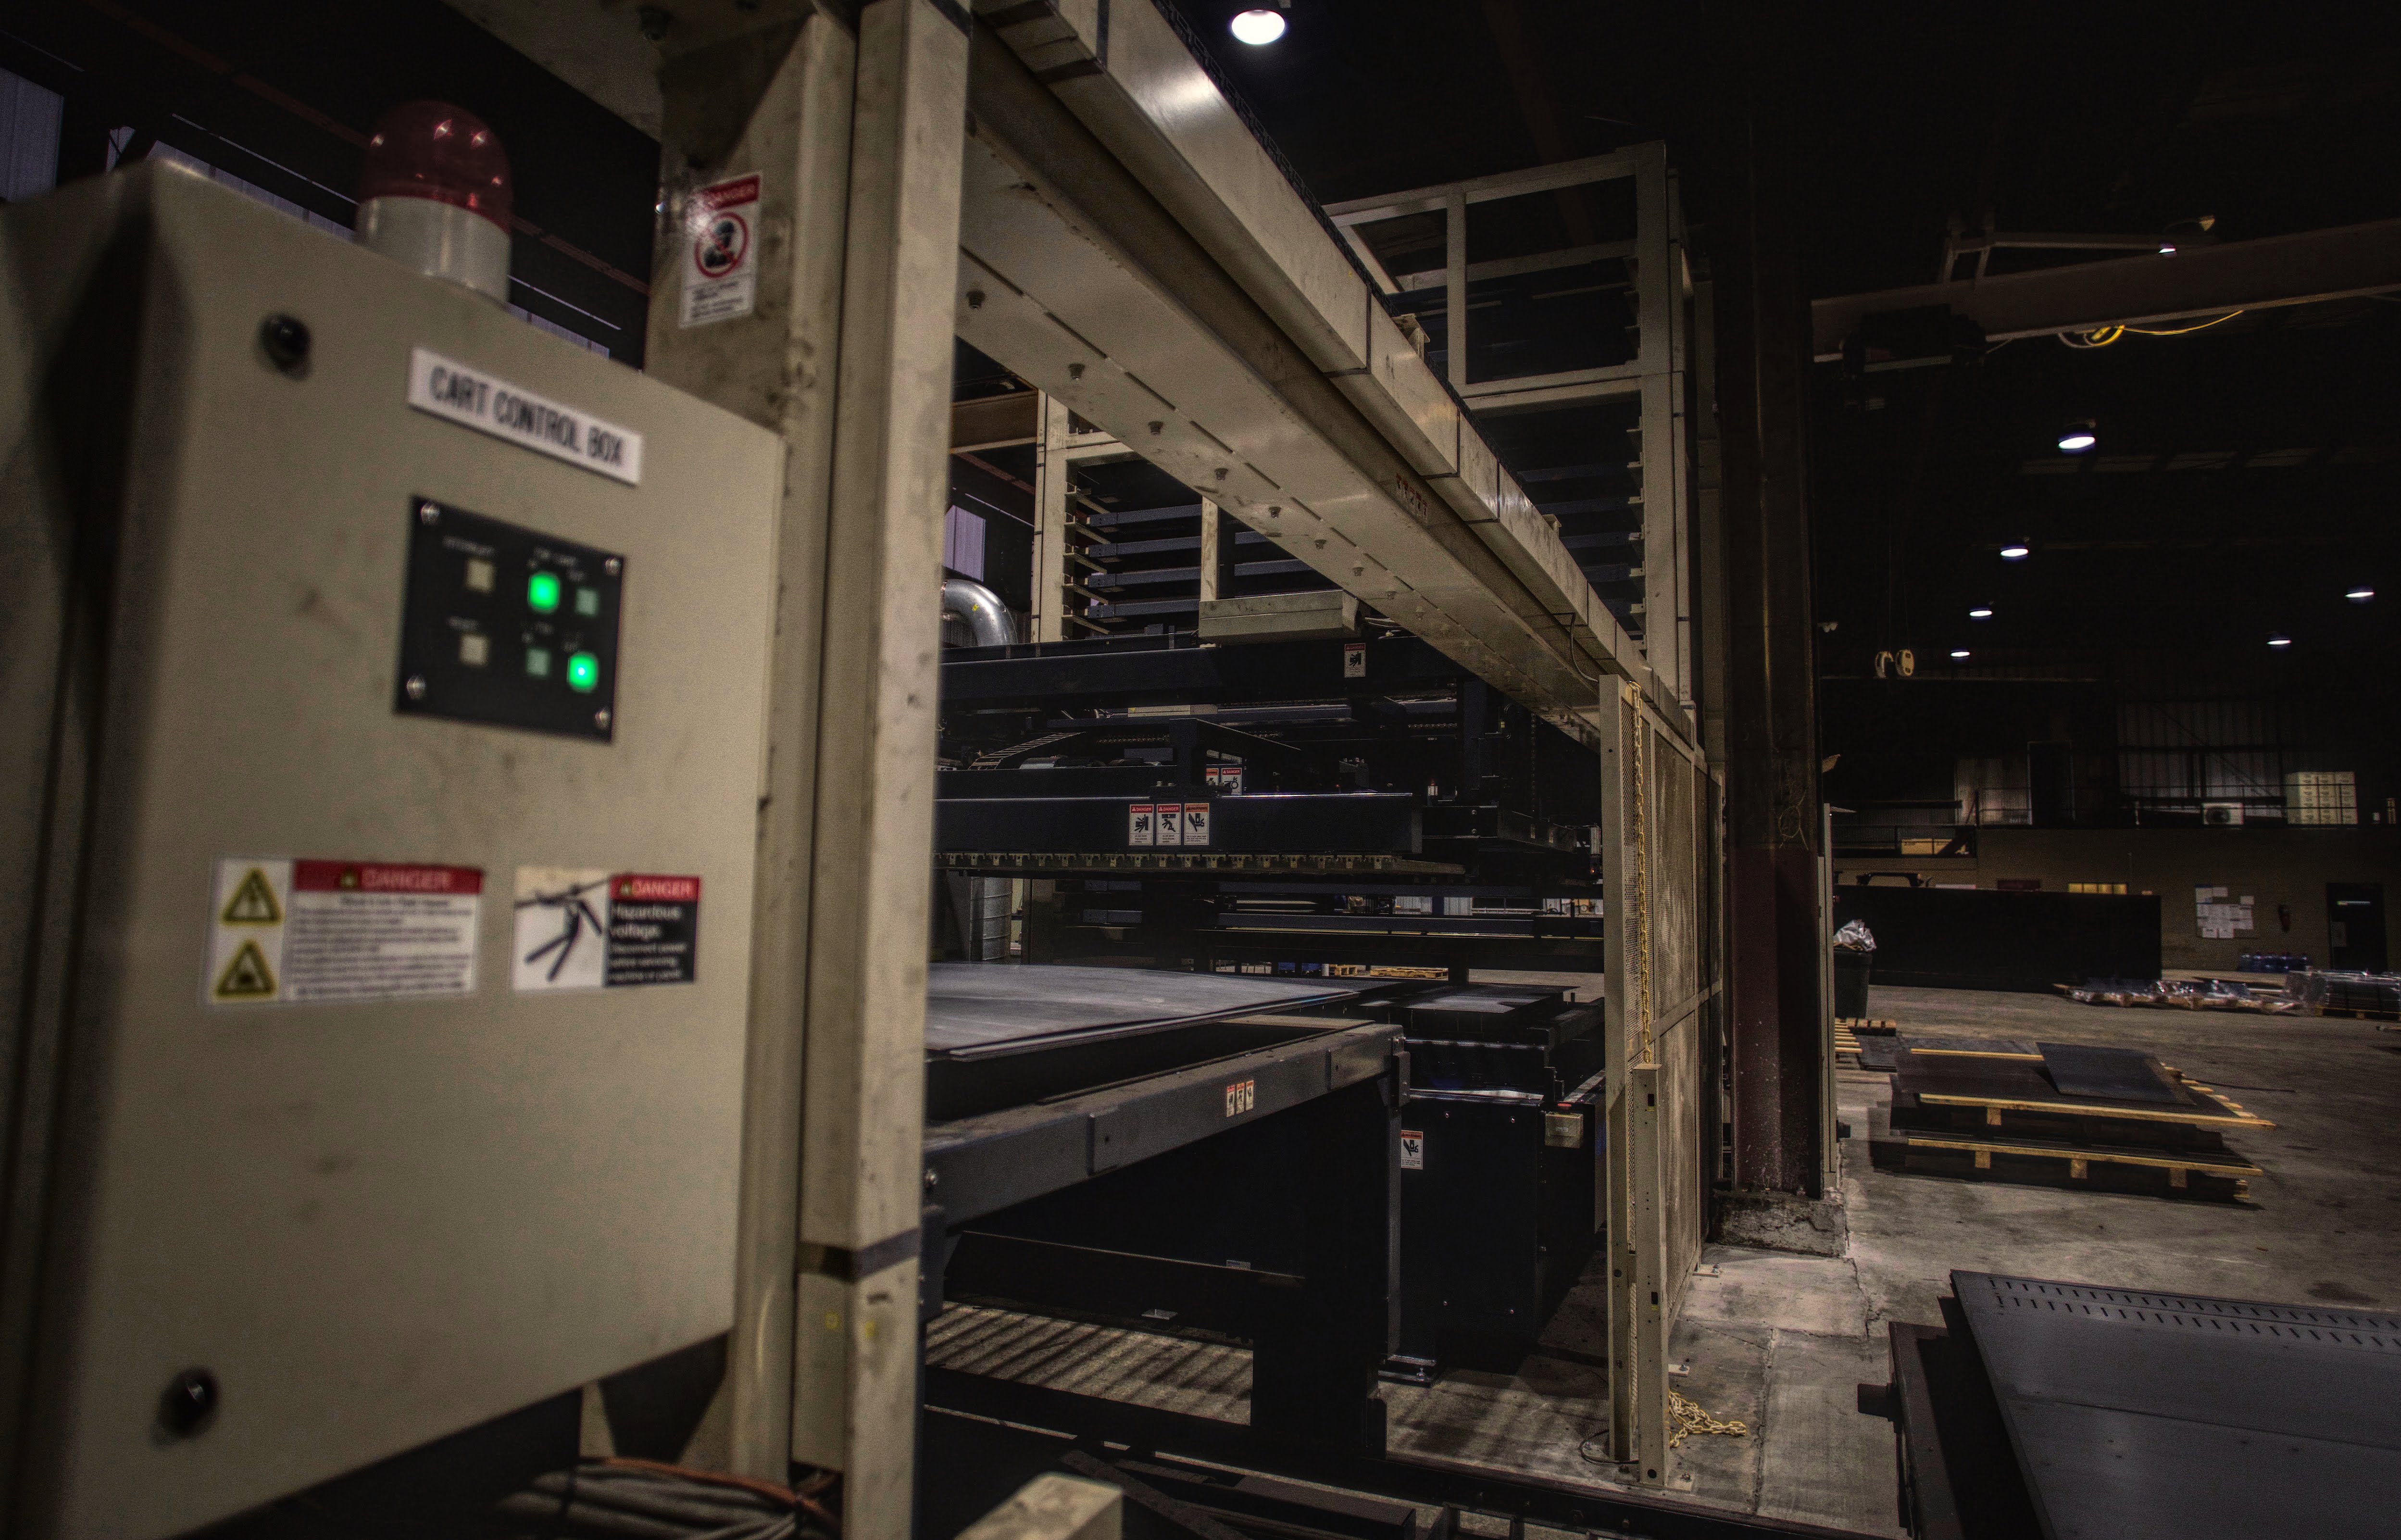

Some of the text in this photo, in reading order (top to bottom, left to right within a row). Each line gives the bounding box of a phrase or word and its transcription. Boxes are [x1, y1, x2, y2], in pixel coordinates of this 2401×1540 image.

[429, 366, 624, 466] CART CONTROL BOX
[362, 868, 452, 890] DANGER
[632, 879, 693, 898] DANGER
[611, 905, 682, 919] Hazardous
